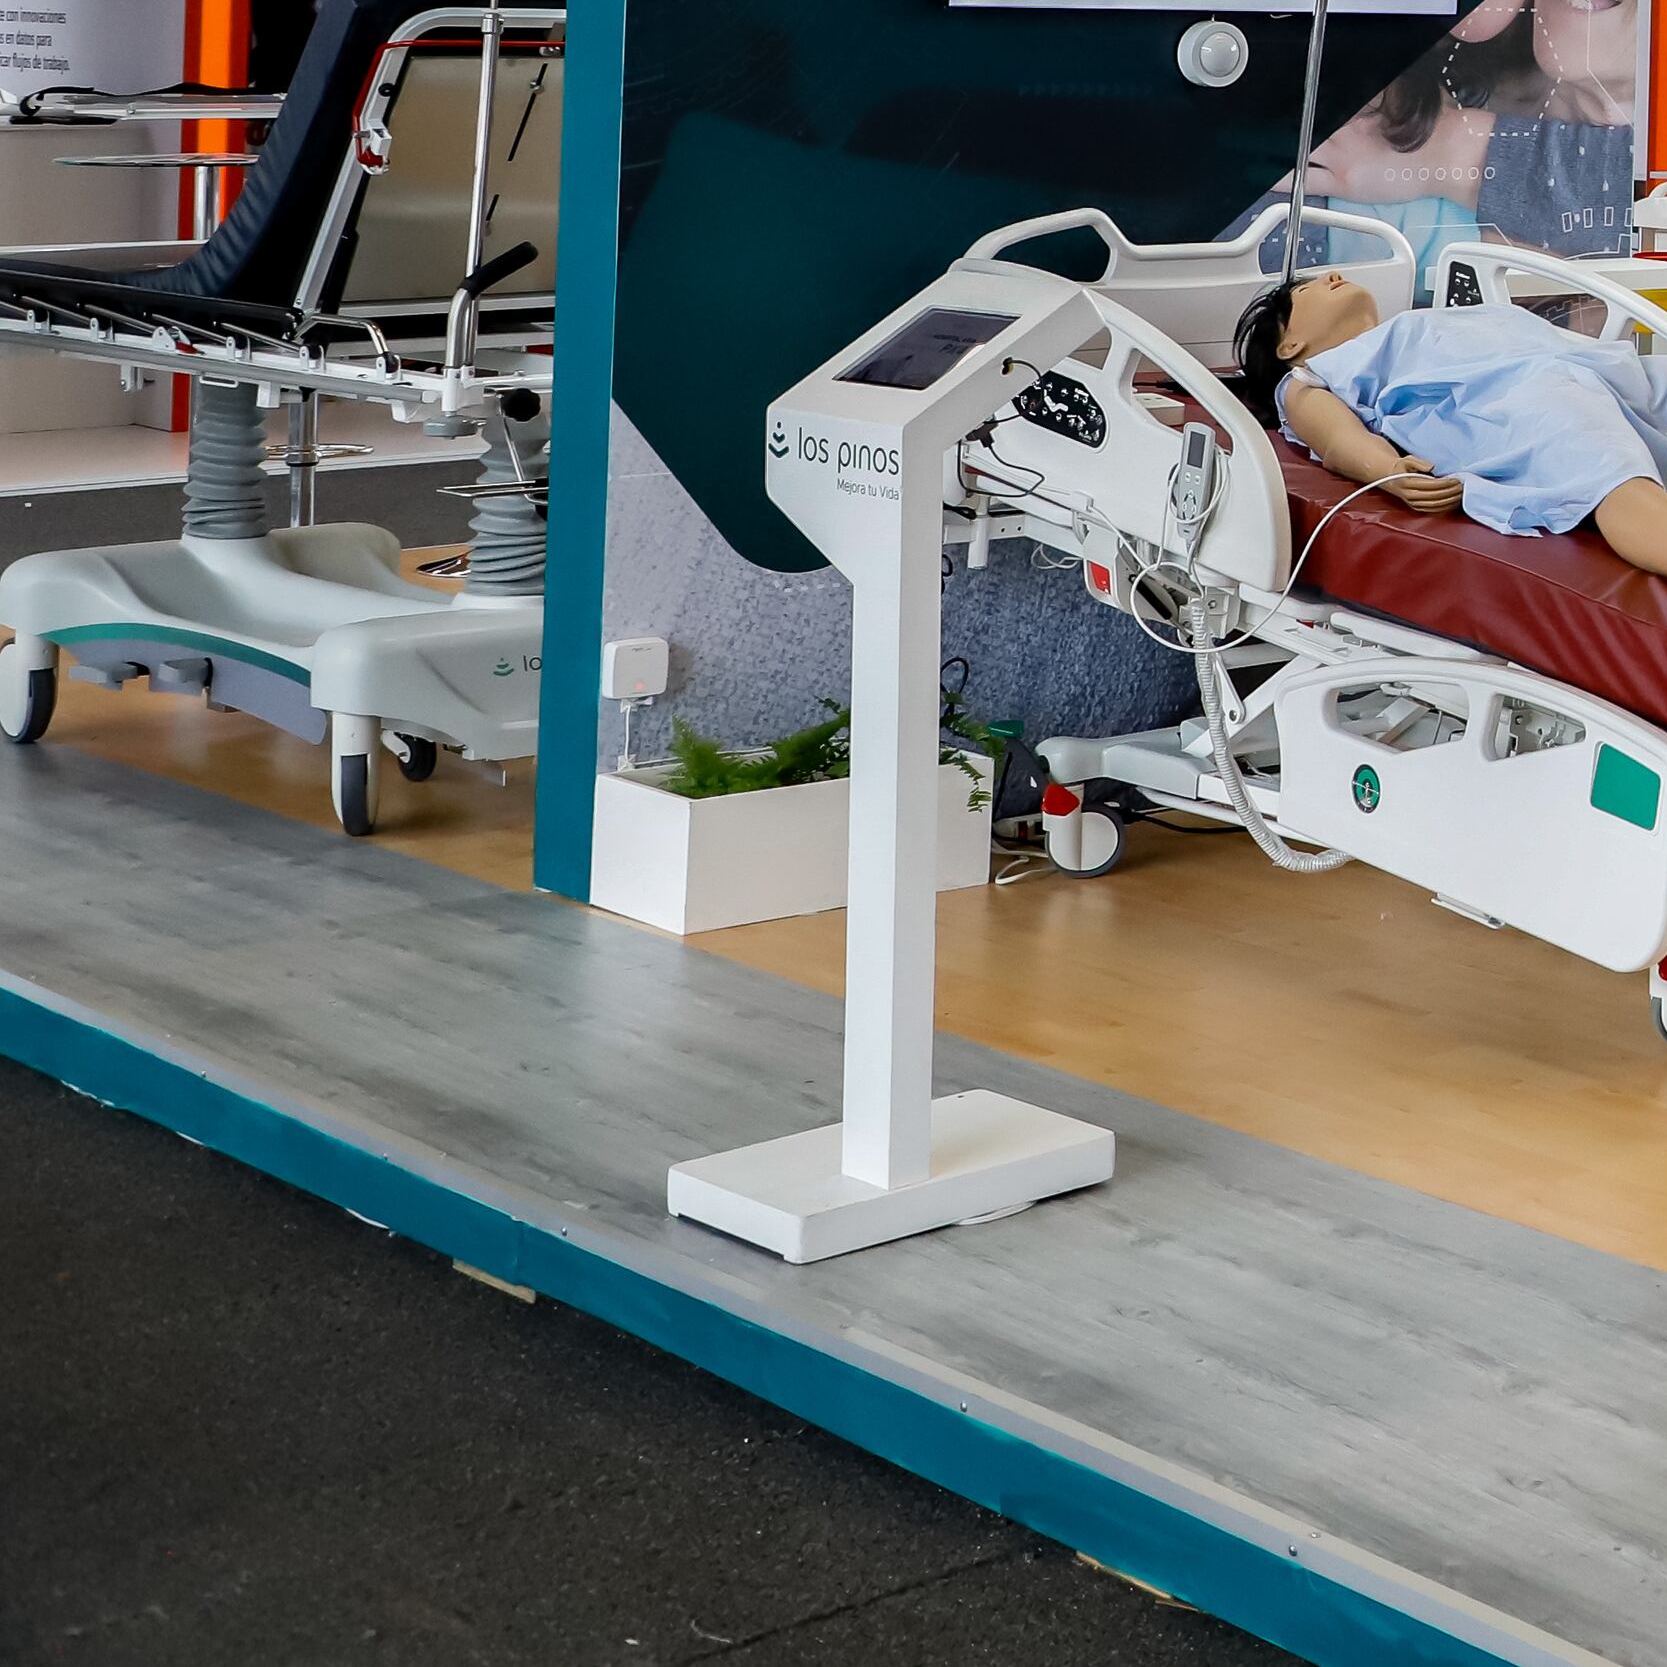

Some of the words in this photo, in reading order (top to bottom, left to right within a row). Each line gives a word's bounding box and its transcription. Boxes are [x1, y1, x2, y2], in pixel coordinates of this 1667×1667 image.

[798, 426, 829, 464] los
[838, 441, 900, 476] pinos
[837, 477, 867, 496] Mejora
[868, 485, 878, 497] tu
[879, 487, 900, 501] Vida
